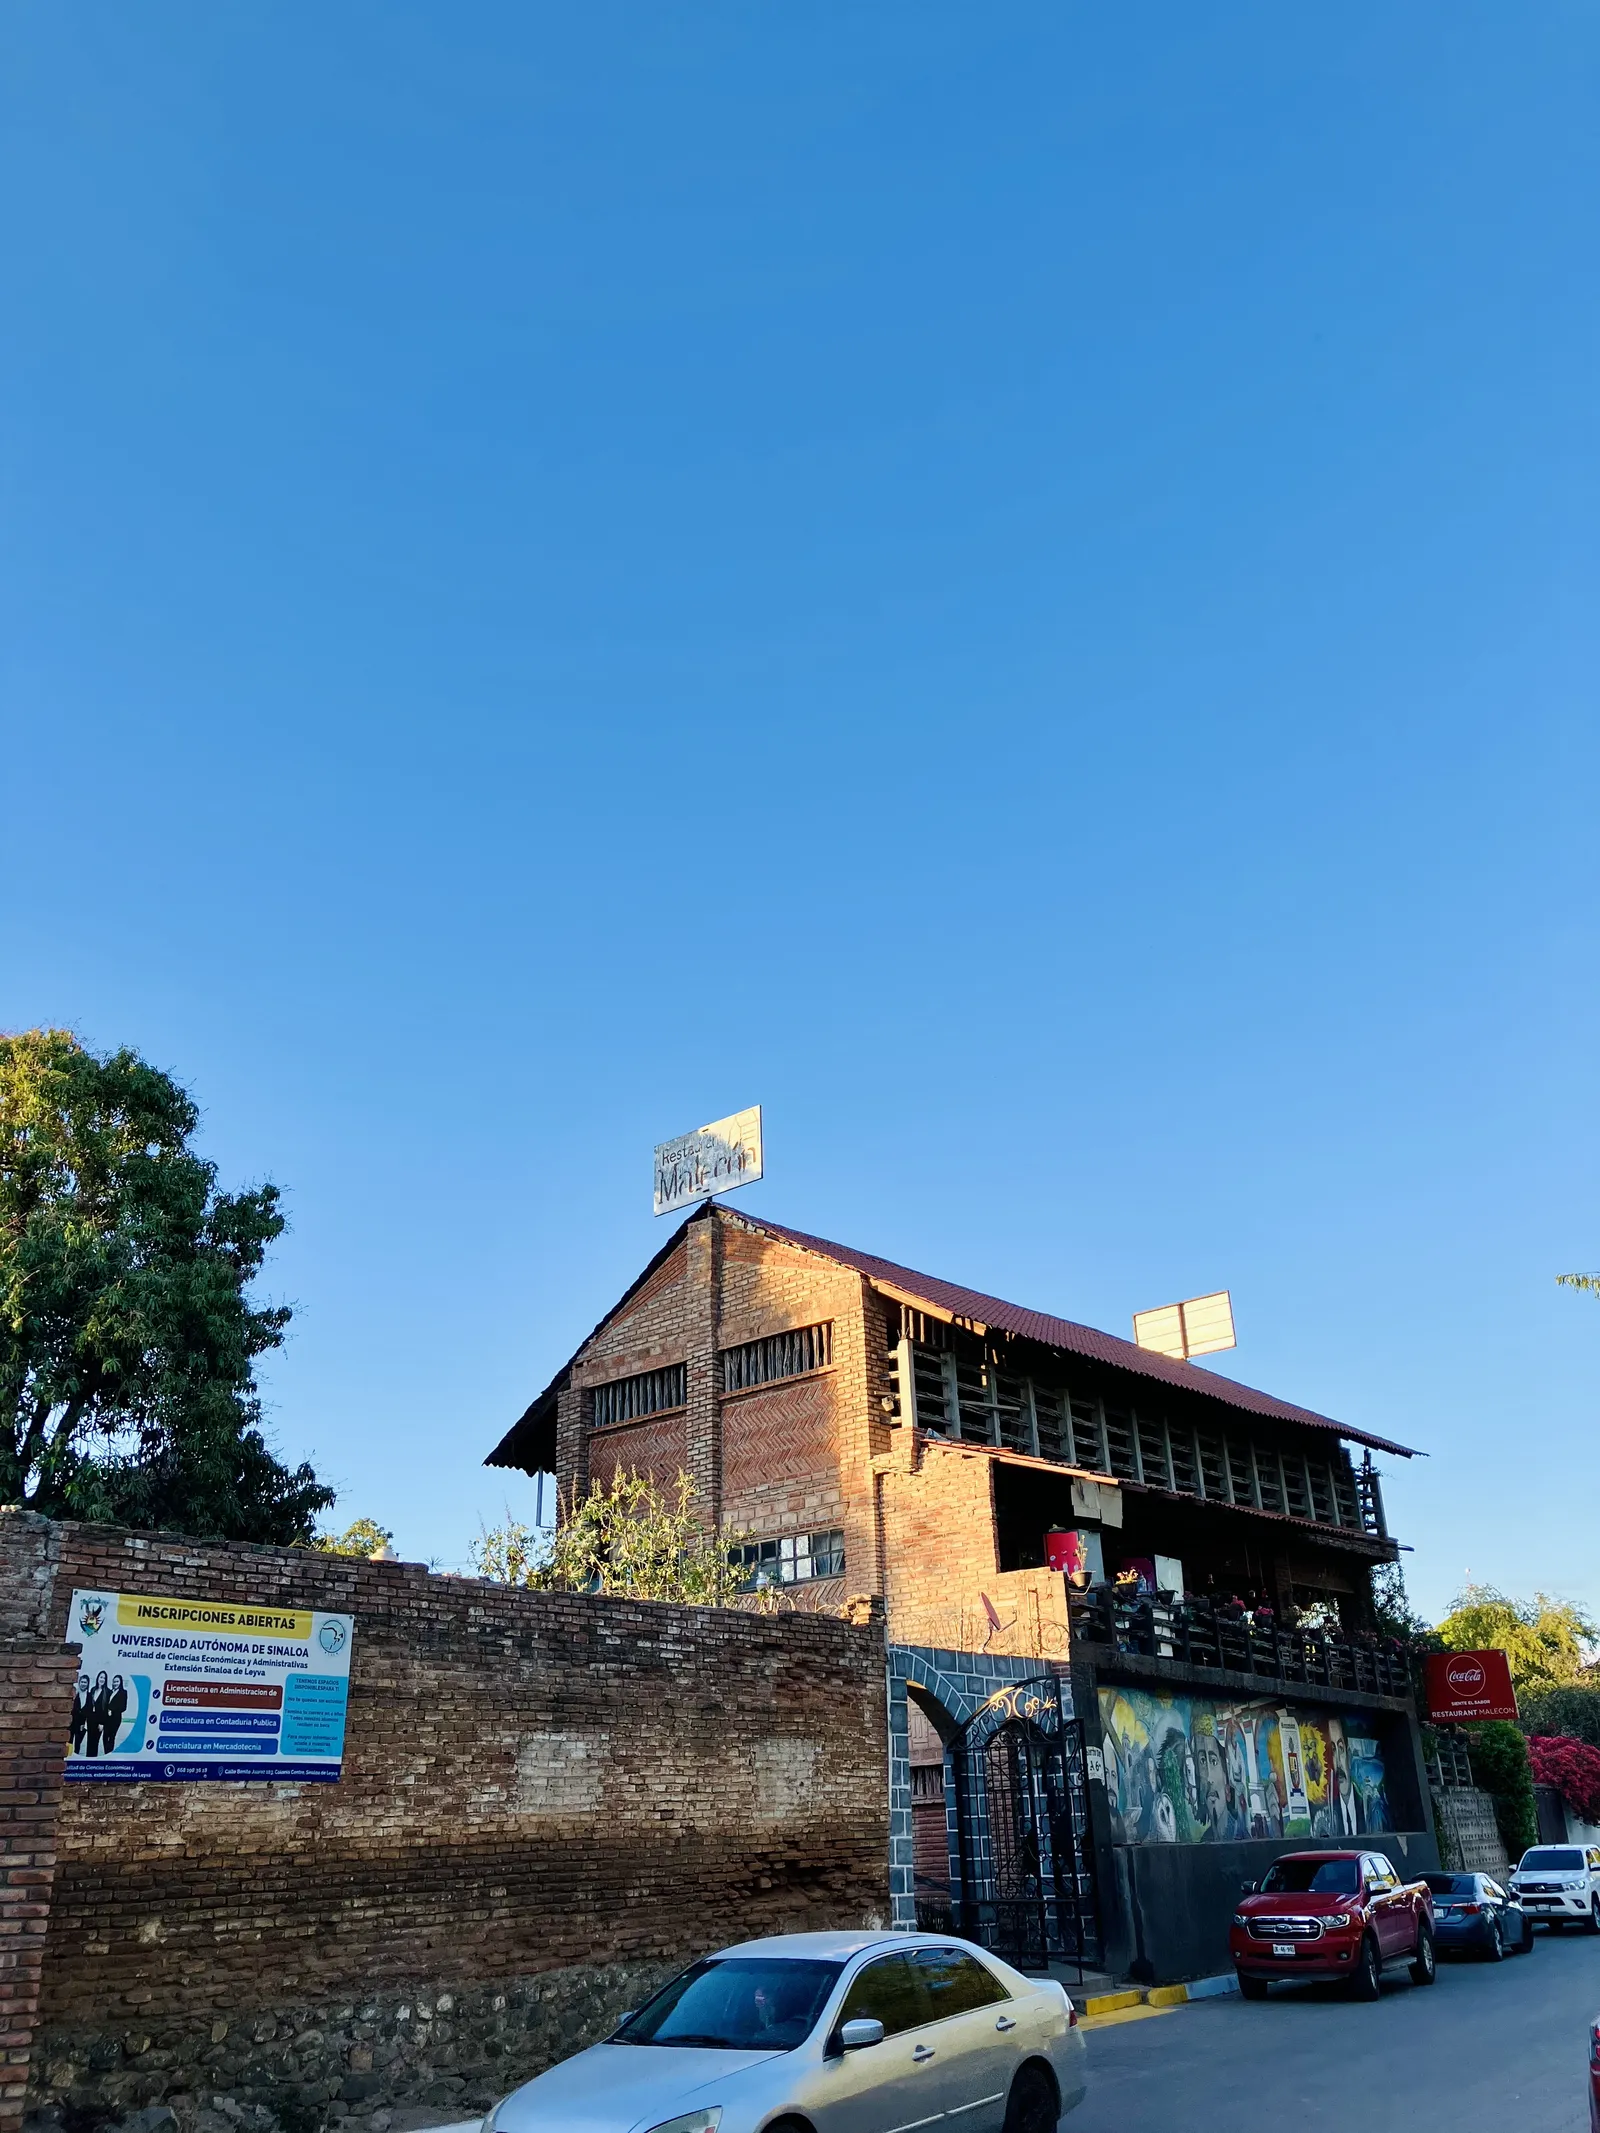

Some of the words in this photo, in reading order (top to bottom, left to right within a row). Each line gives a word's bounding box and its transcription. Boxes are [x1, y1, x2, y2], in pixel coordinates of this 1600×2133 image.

[137, 1605, 235, 1624] INSCRIPCIONES
[237, 1614, 295, 1629] ABIERTAS
[112, 1634, 188, 1649] UNIVERSIDAD
[190, 1639, 249, 1653] AUTÓNOMA
[251, 1644, 265, 1654] DE
[267, 1645, 309, 1657] SINALOA
[117, 1650, 154, 1659] Facultad
[155, 1652, 166, 1660] de
[167, 1653, 200, 1662] Ciencias
[201, 1655, 246, 1665] Económicas
[247, 1659, 252, 1667] y
[253, 1658, 308, 1669] Administrativas
[164, 1664, 202, 1672] Extensión
[204, 1665, 232, 1674] Sinaloa
[233, 1667, 243, 1675] de
[244, 1668, 265, 1677] Leyva
[166, 1684, 208, 1693] Licenciatura
[268, 1688, 277, 1696] de
[164, 1696, 199, 1705] Empresas
[1432, 1709, 1477, 1718] RESTAURANT
[1479, 1707, 1514, 1715] MALECON
[161, 1716, 205, 1725] Licenciatura
[158, 1741, 202, 1750] Licenciatura
